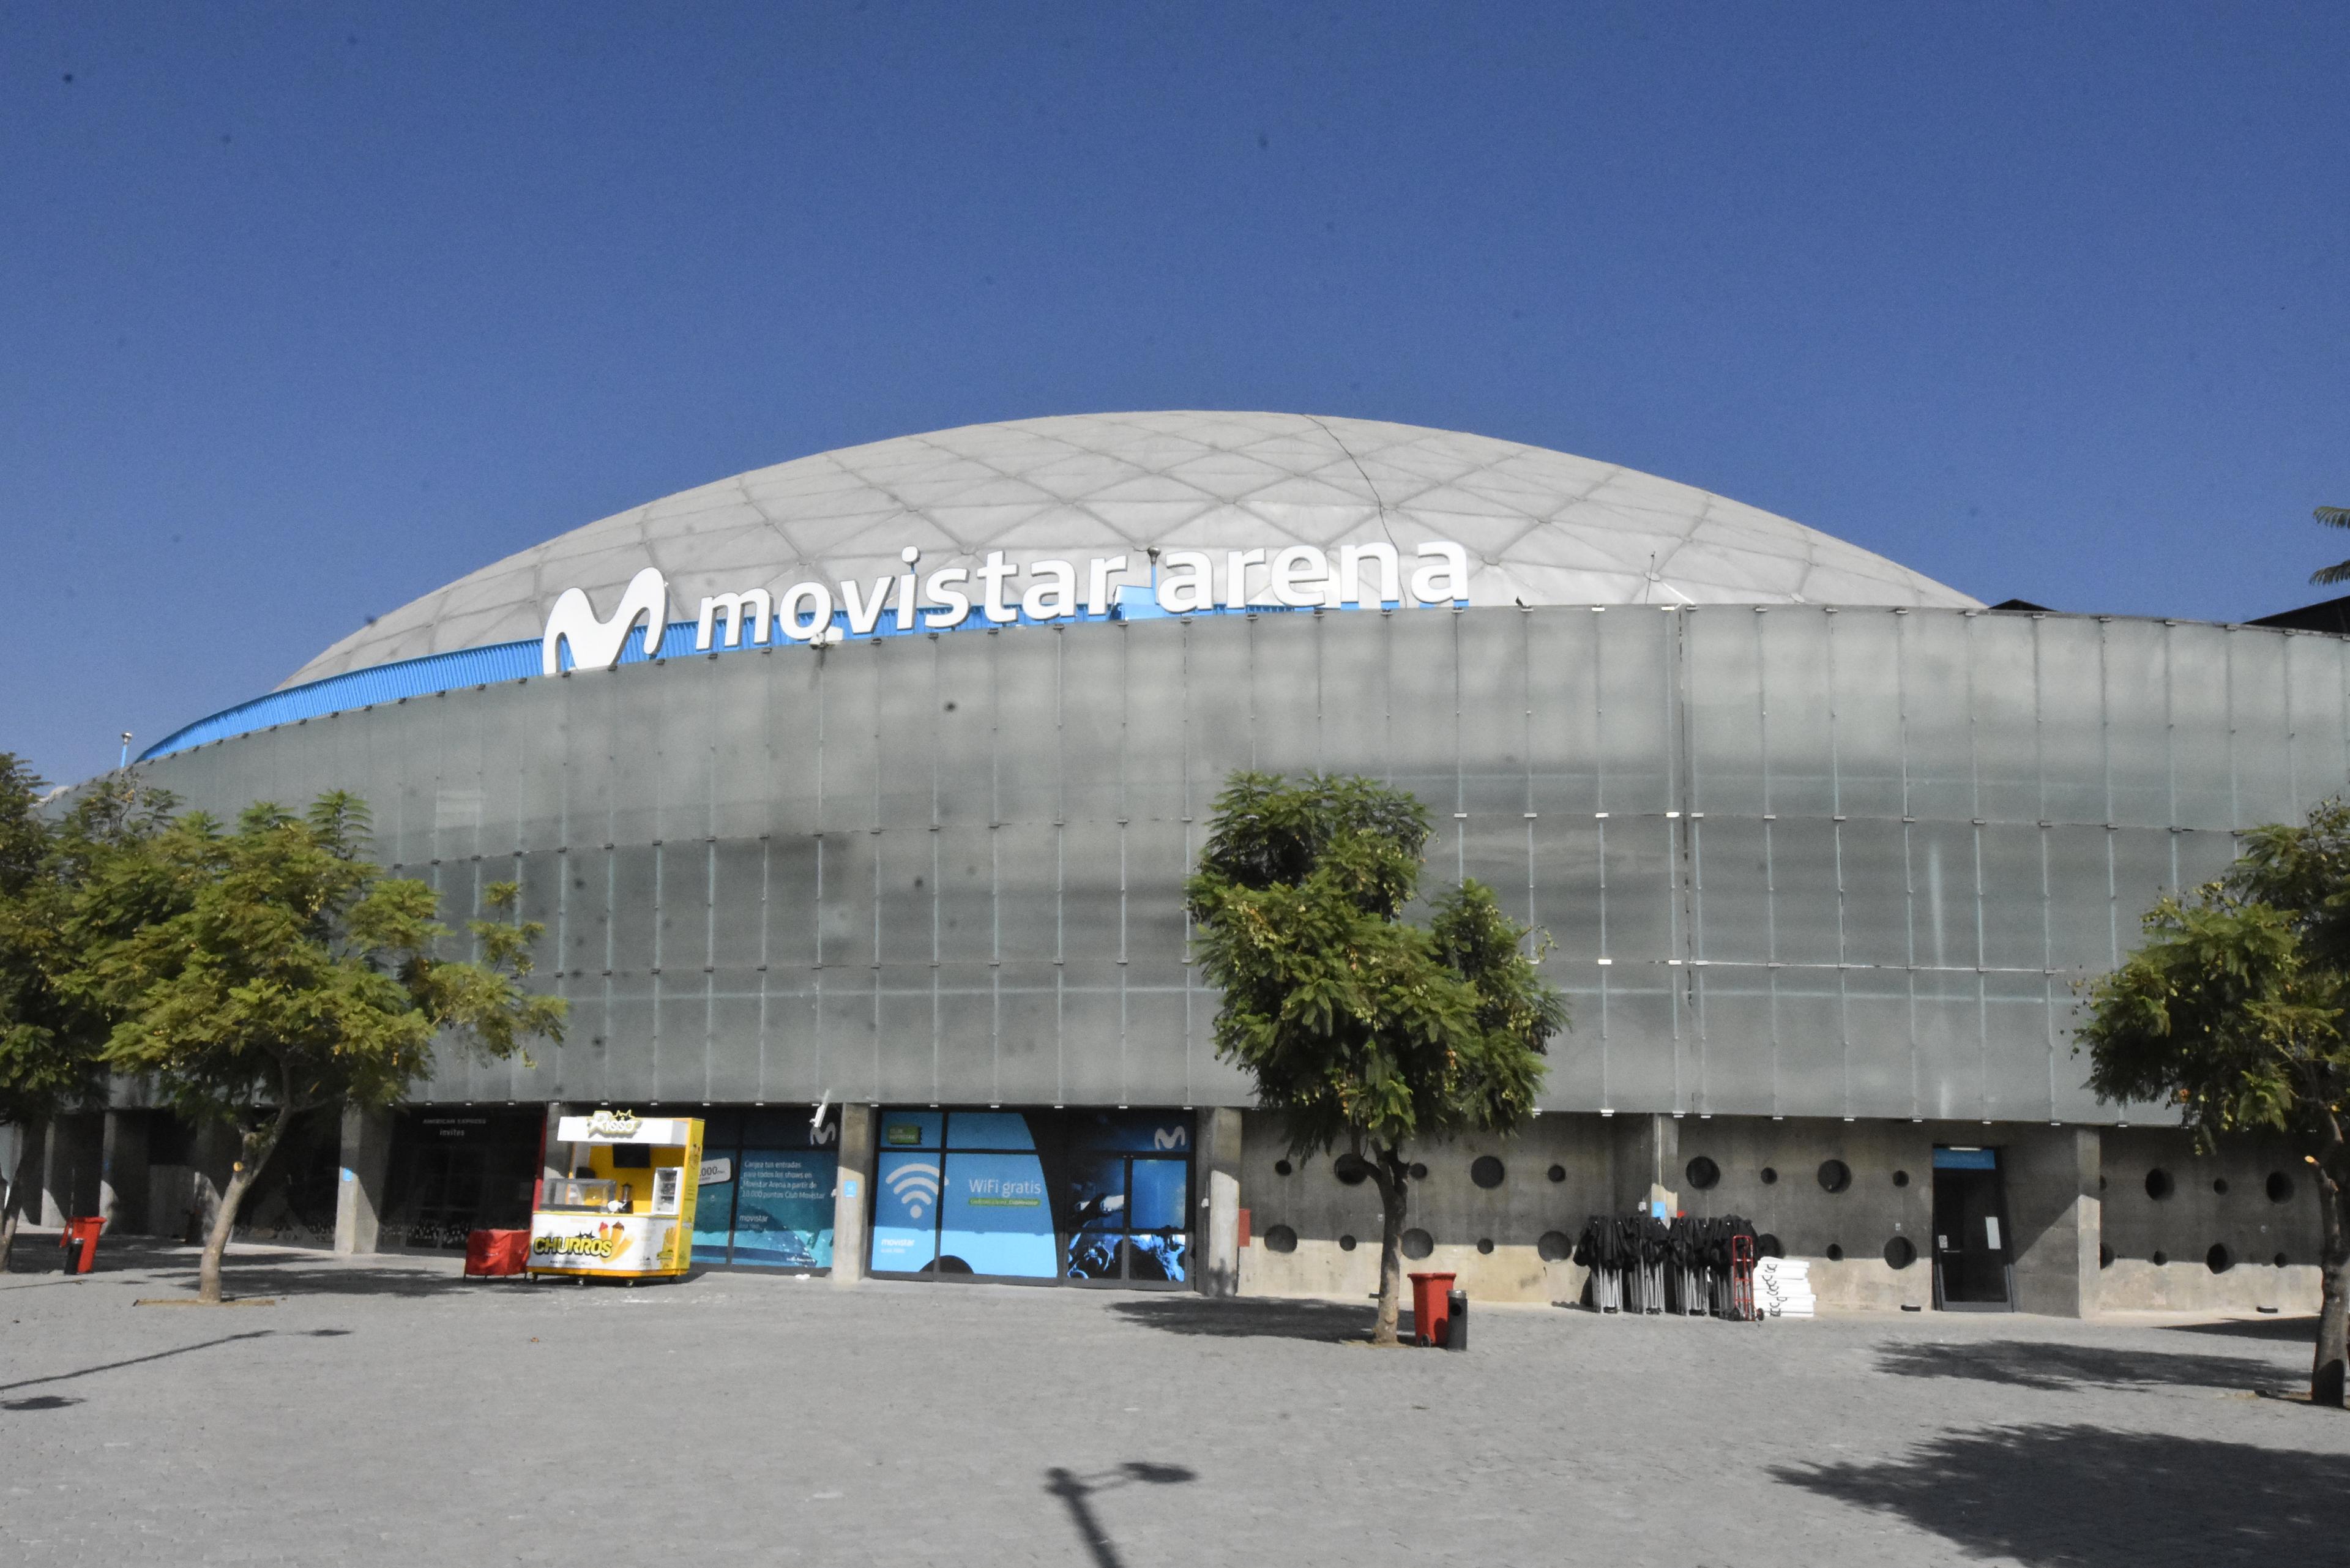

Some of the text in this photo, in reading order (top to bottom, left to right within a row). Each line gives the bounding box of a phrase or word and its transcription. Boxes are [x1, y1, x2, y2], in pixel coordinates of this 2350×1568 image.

[695, 545, 1128, 651] movistar
[1157, 540, 1469, 614] arena
[792, 1181, 808, 1190] partir
[969, 1179, 1042, 1198] WiFi gratis
[739, 1214, 769, 1223] movistar
[534, 1236, 613, 1258] CHURROS
